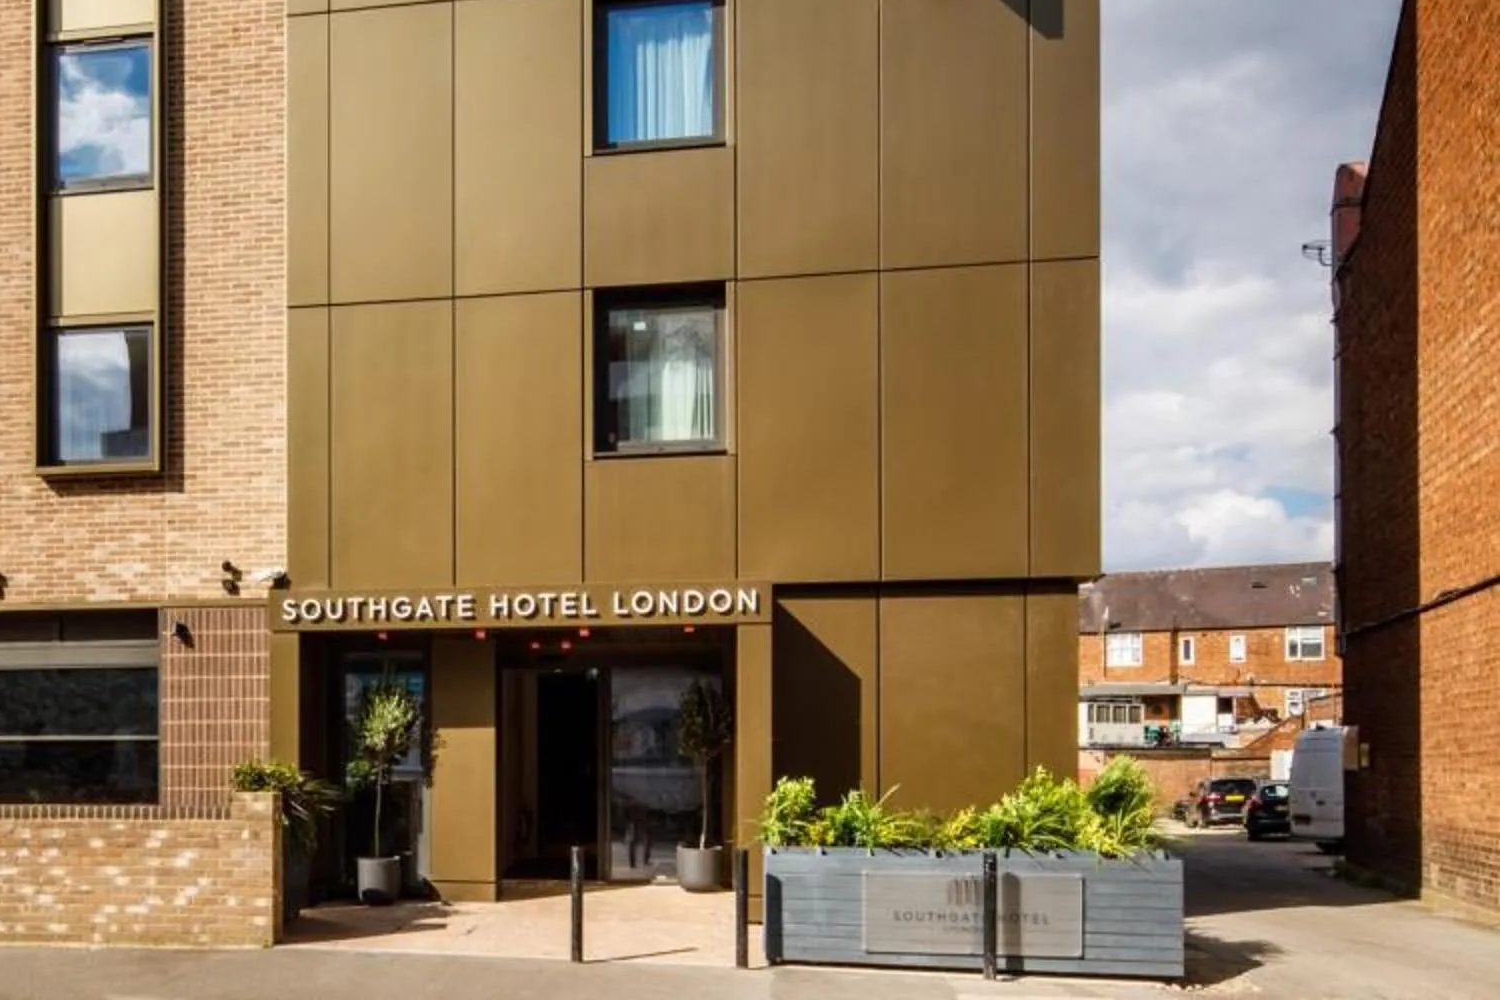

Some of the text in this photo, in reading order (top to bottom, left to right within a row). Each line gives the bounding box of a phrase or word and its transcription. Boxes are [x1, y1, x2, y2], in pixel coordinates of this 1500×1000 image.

[281, 588, 758, 621] SOUTHGATE HOTEL LONDON
[893, 909, 984, 923] SOUTHGAT
